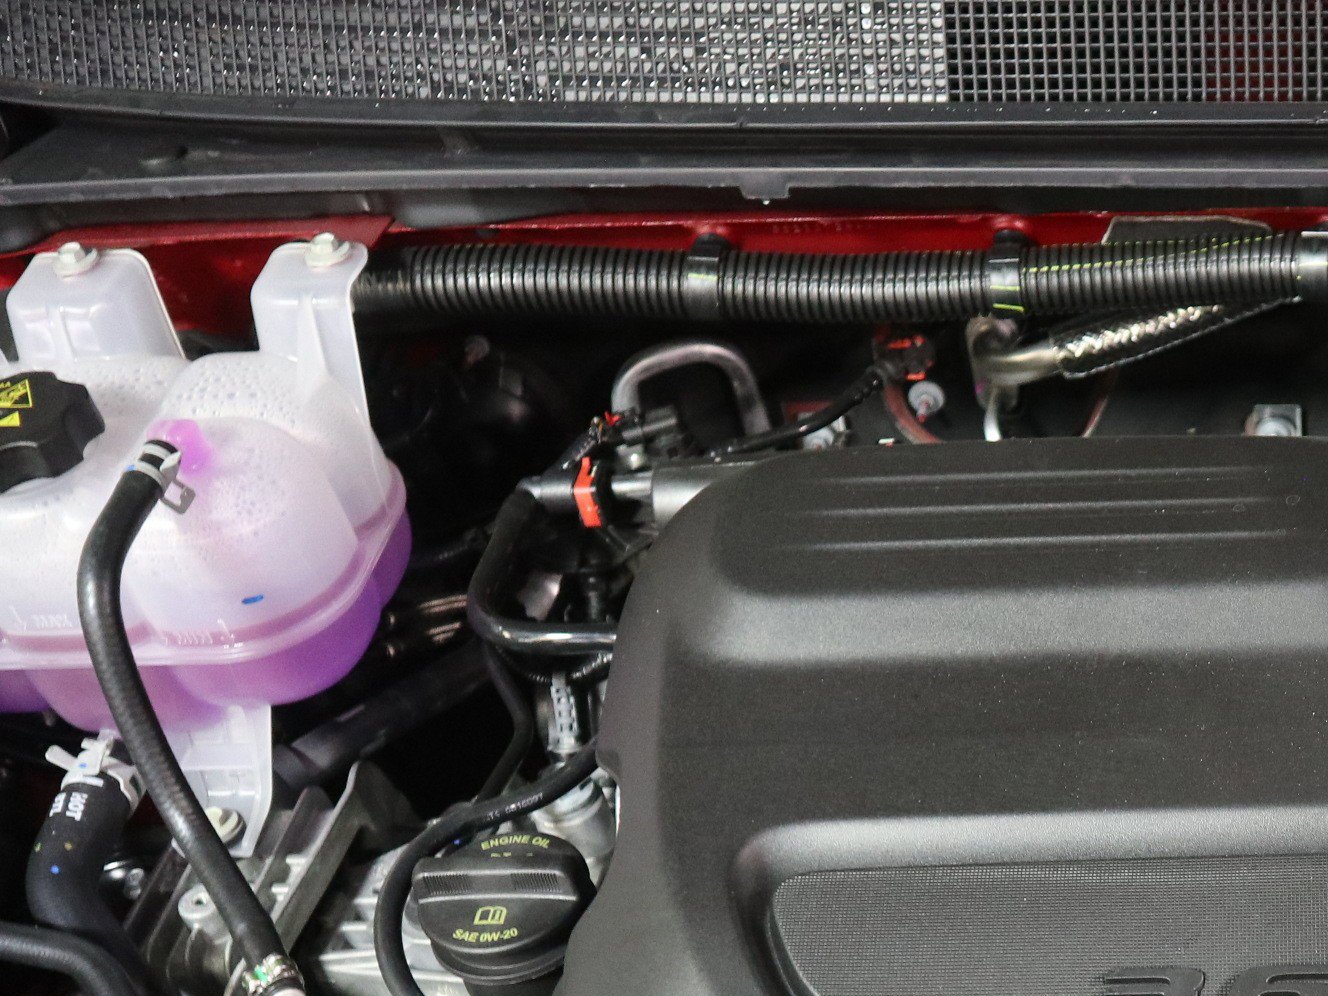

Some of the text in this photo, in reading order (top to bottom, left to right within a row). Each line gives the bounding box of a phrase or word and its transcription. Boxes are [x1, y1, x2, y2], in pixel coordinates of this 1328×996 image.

[480, 834, 550, 851] ENGINE OIL
[452, 927, 519, 943] SAE 0W-20
